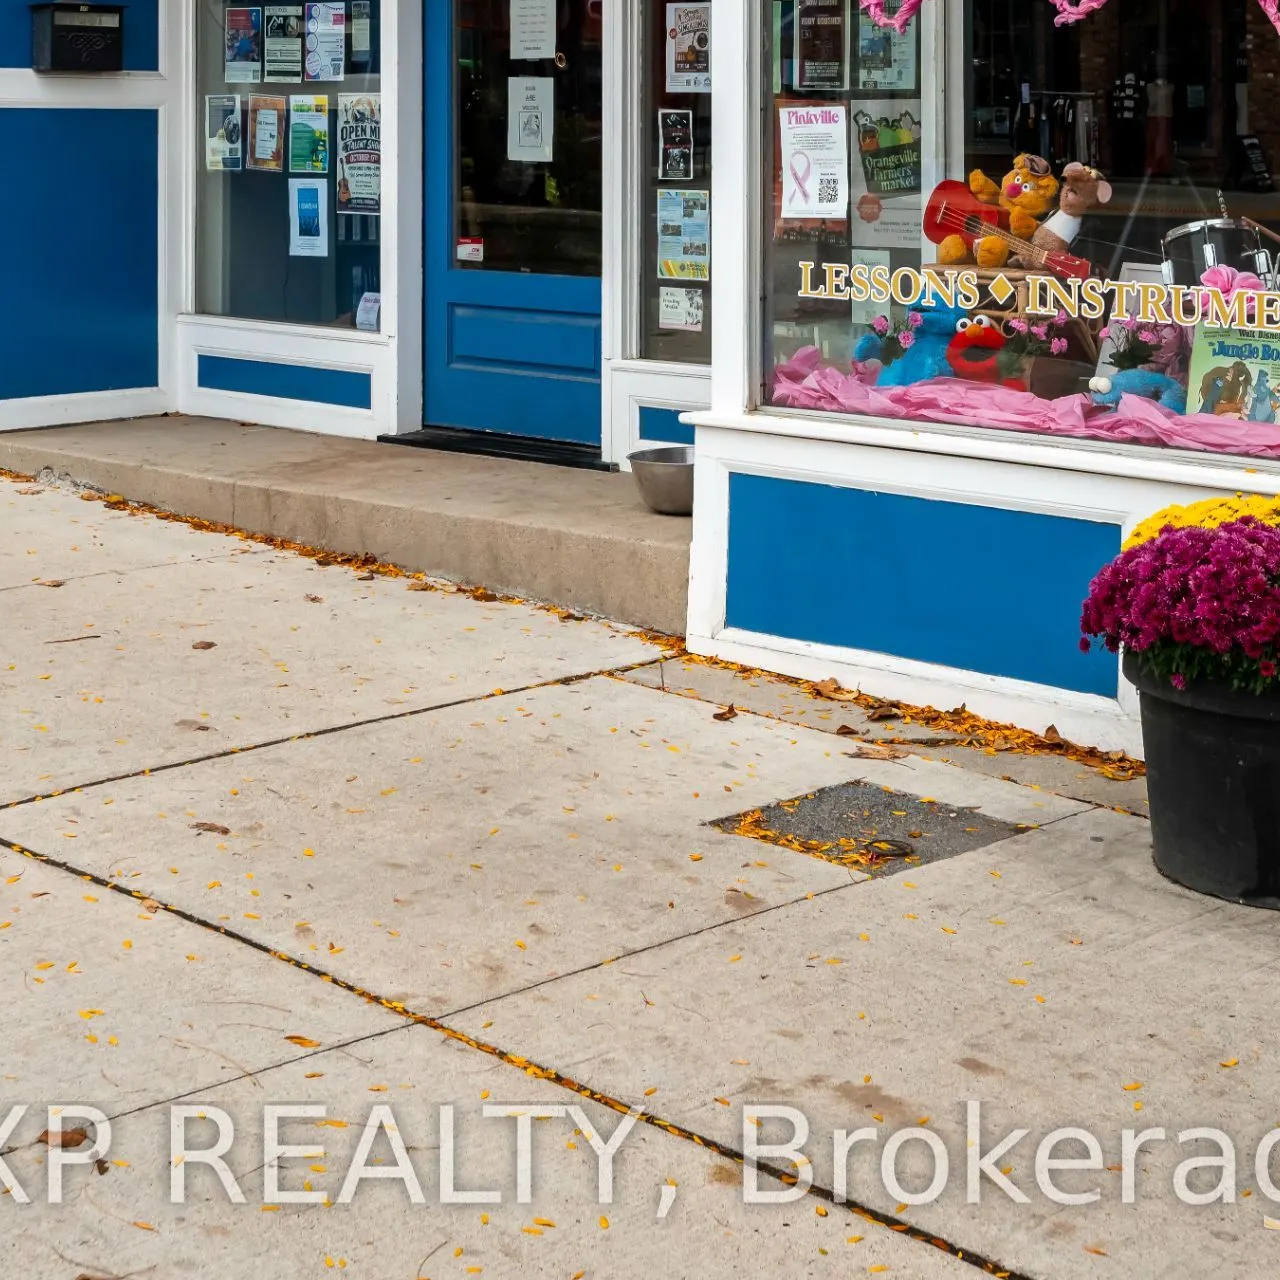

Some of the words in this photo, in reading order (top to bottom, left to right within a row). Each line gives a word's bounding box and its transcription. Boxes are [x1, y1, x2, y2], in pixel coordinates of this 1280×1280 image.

[787, 110, 840, 126] Pinkville
[341, 125, 367, 141] OPEN
[865, 150, 919, 169] Orangeville
[880, 176, 915, 191] market
[797, 261, 980, 310] LESSONS
[1212, 339, 1260, 360] Jungle
